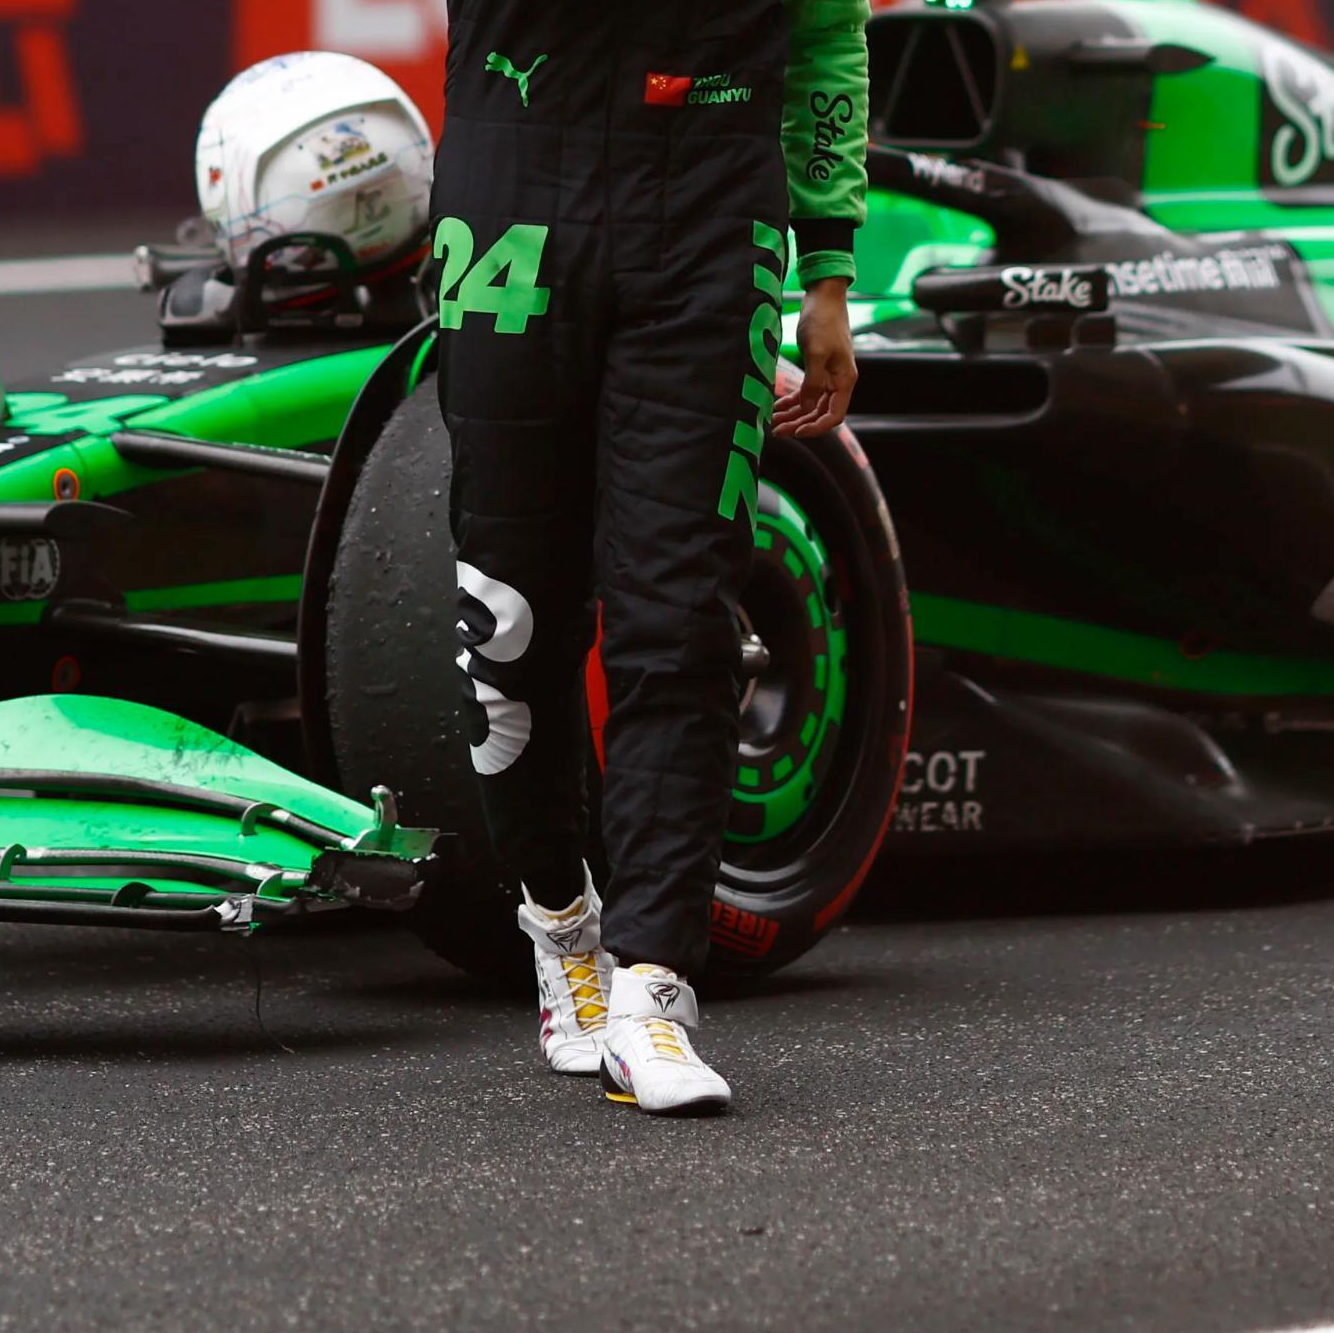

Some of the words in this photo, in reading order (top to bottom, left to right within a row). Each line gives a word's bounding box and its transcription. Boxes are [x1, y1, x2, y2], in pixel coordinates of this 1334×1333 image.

[687, 87, 752, 105] GUANYU
[806, 90, 853, 181] Stake
[432, 217, 551, 334] 24
[1000, 265, 1093, 309] Stake
[900, 750, 987, 793] COT
